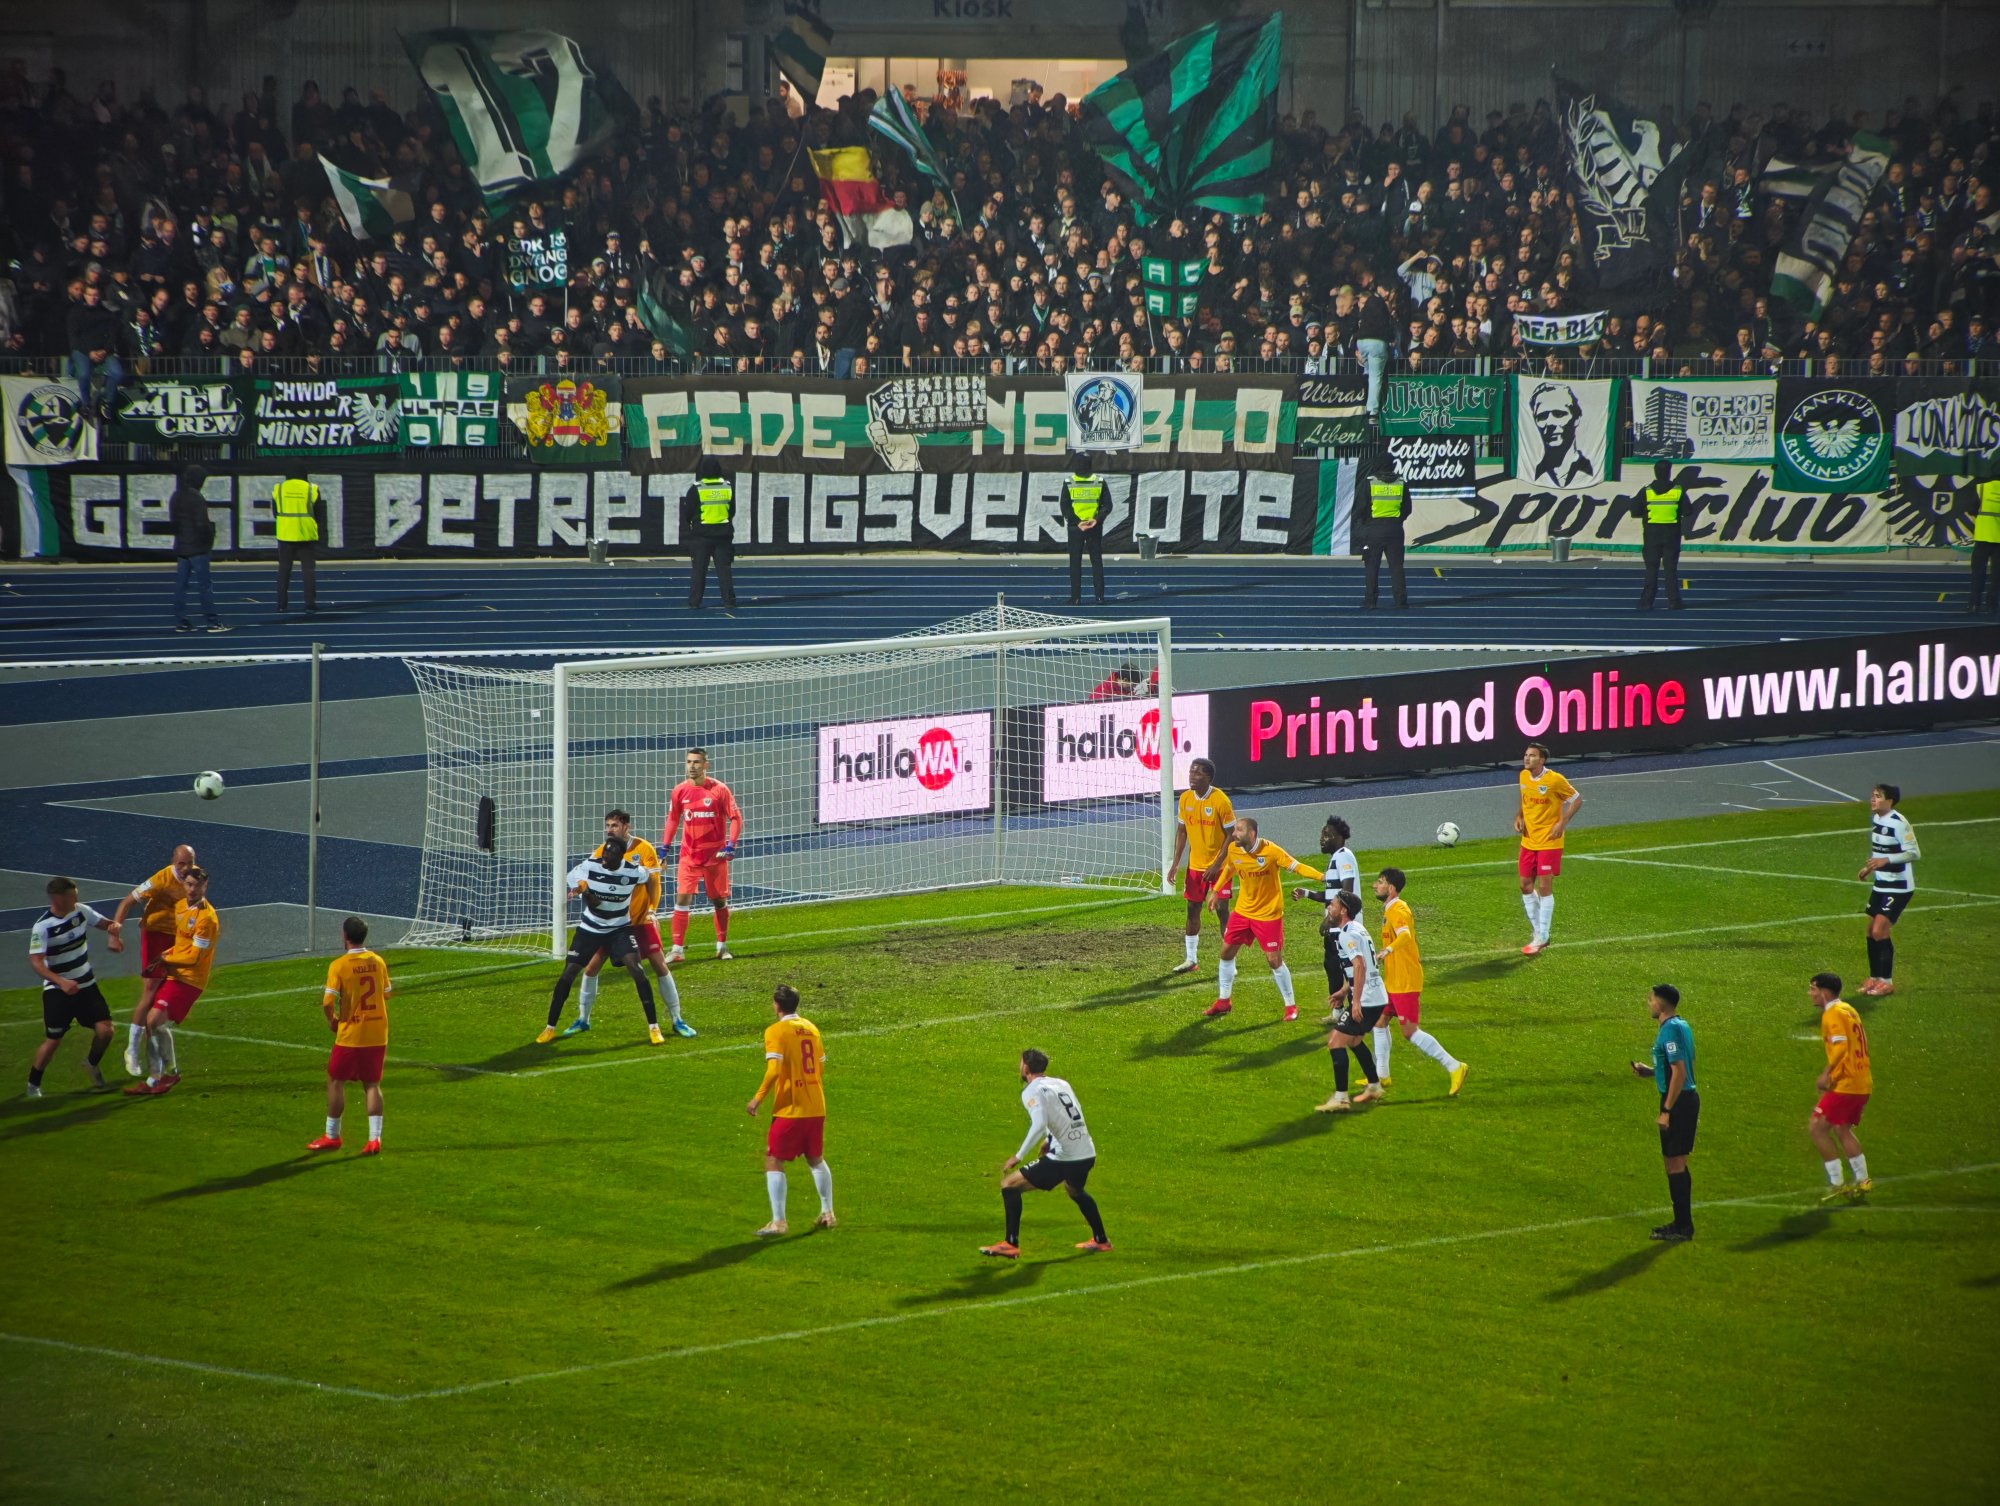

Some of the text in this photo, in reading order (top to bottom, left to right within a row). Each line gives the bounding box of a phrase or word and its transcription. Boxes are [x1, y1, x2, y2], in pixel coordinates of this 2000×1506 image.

[892, 376, 987, 393] SEKTION
[1299, 379, 1366, 404] Ultras
[401, 400, 496, 417] ULTRAS
[892, 390, 987, 409] STADION
[1690, 393, 1775, 417] COERDE
[1793, 392, 1876, 422] FAN-KLUB
[161, 415, 240, 437] CREW
[887, 406, 987, 424] VERBOT
[1700, 416, 1768, 437] BANDE
[256, 422, 355, 446] MÜNSTER
[1303, 424, 1365, 443] Liberi
[1387, 436, 1470, 466] Kategorie
[1786, 436, 1880, 478] RHEIN-RUHR
[1393, 459, 1466, 484] Münster
[1249, 696, 1378, 762] Print
[1398, 682, 1495, 748] und
[1515, 670, 1685, 737] Online
[359, 975, 377, 1011] 2
[800, 1039, 815, 1074] 8
[1058, 1092, 1081, 1121] 8
